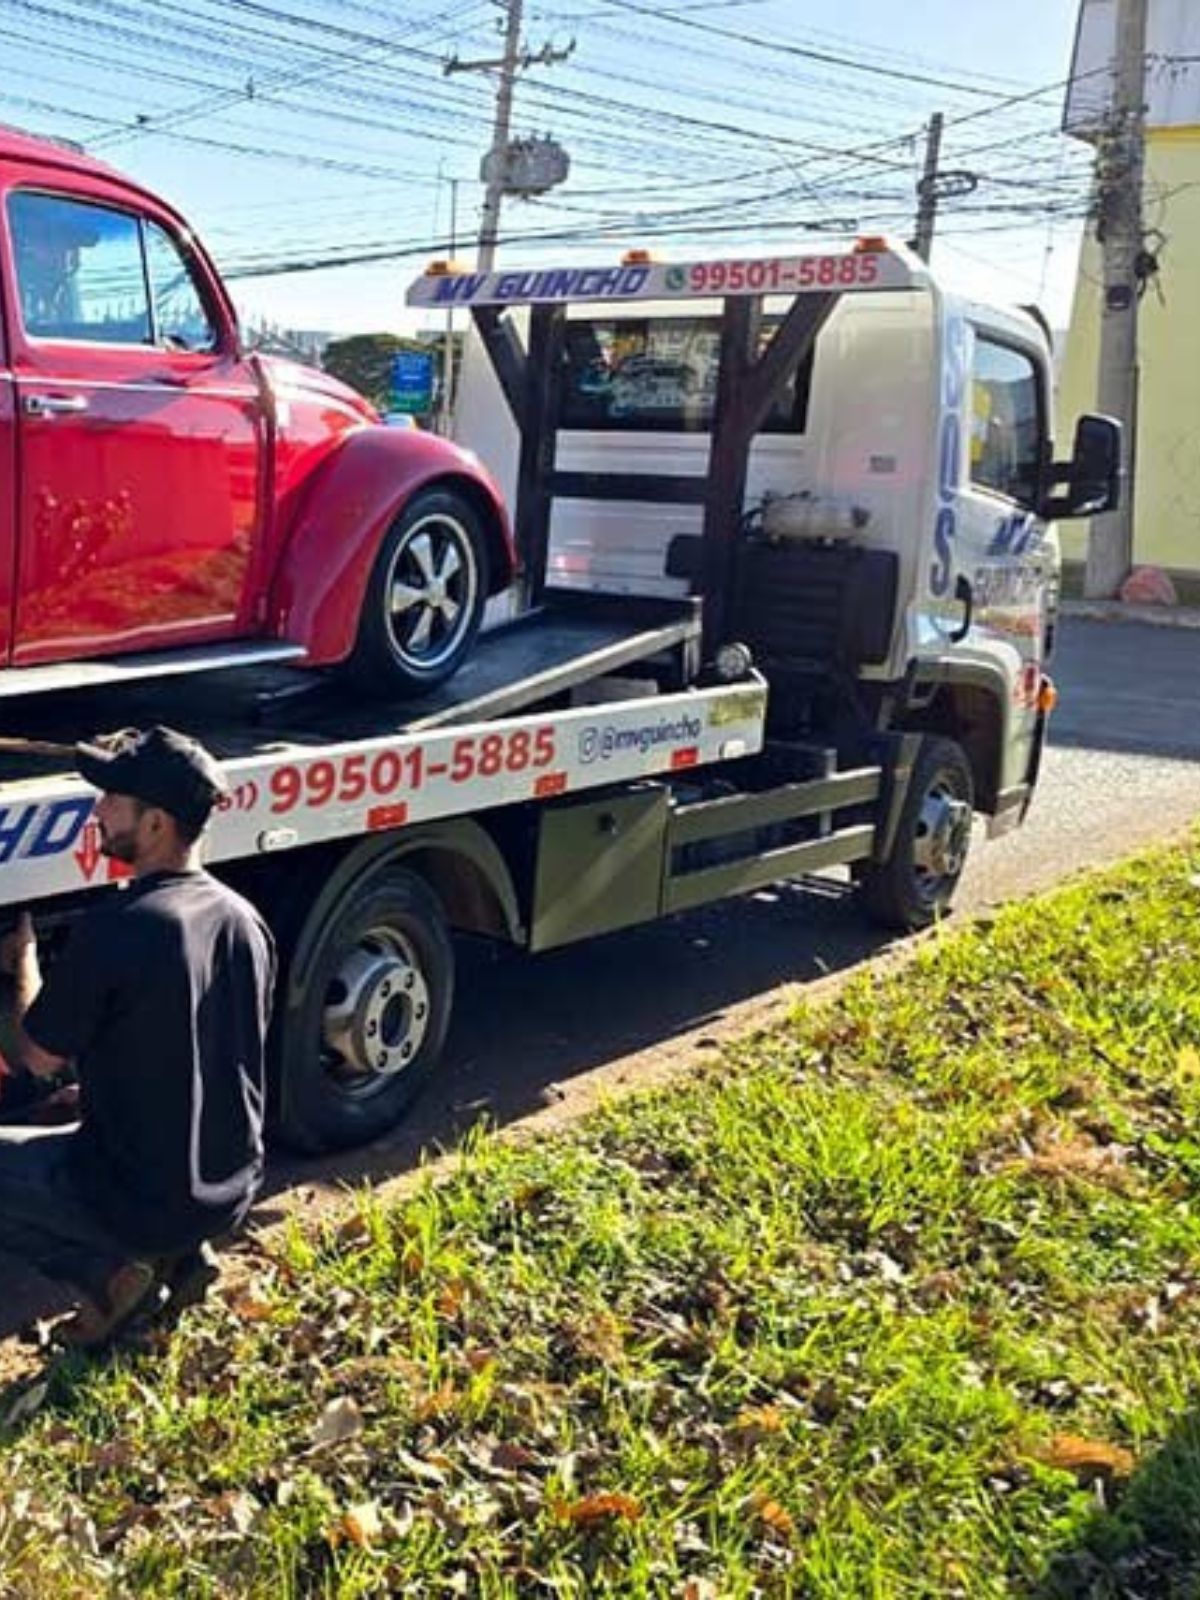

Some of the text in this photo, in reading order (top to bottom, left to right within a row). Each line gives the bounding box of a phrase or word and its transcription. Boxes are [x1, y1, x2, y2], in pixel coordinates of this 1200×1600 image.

[435, 255, 880, 302] MV GUINCHO 99501-5885
[600, 713, 701, 760] @mvguincho
[270, 725, 556, 814] 99501-5885
